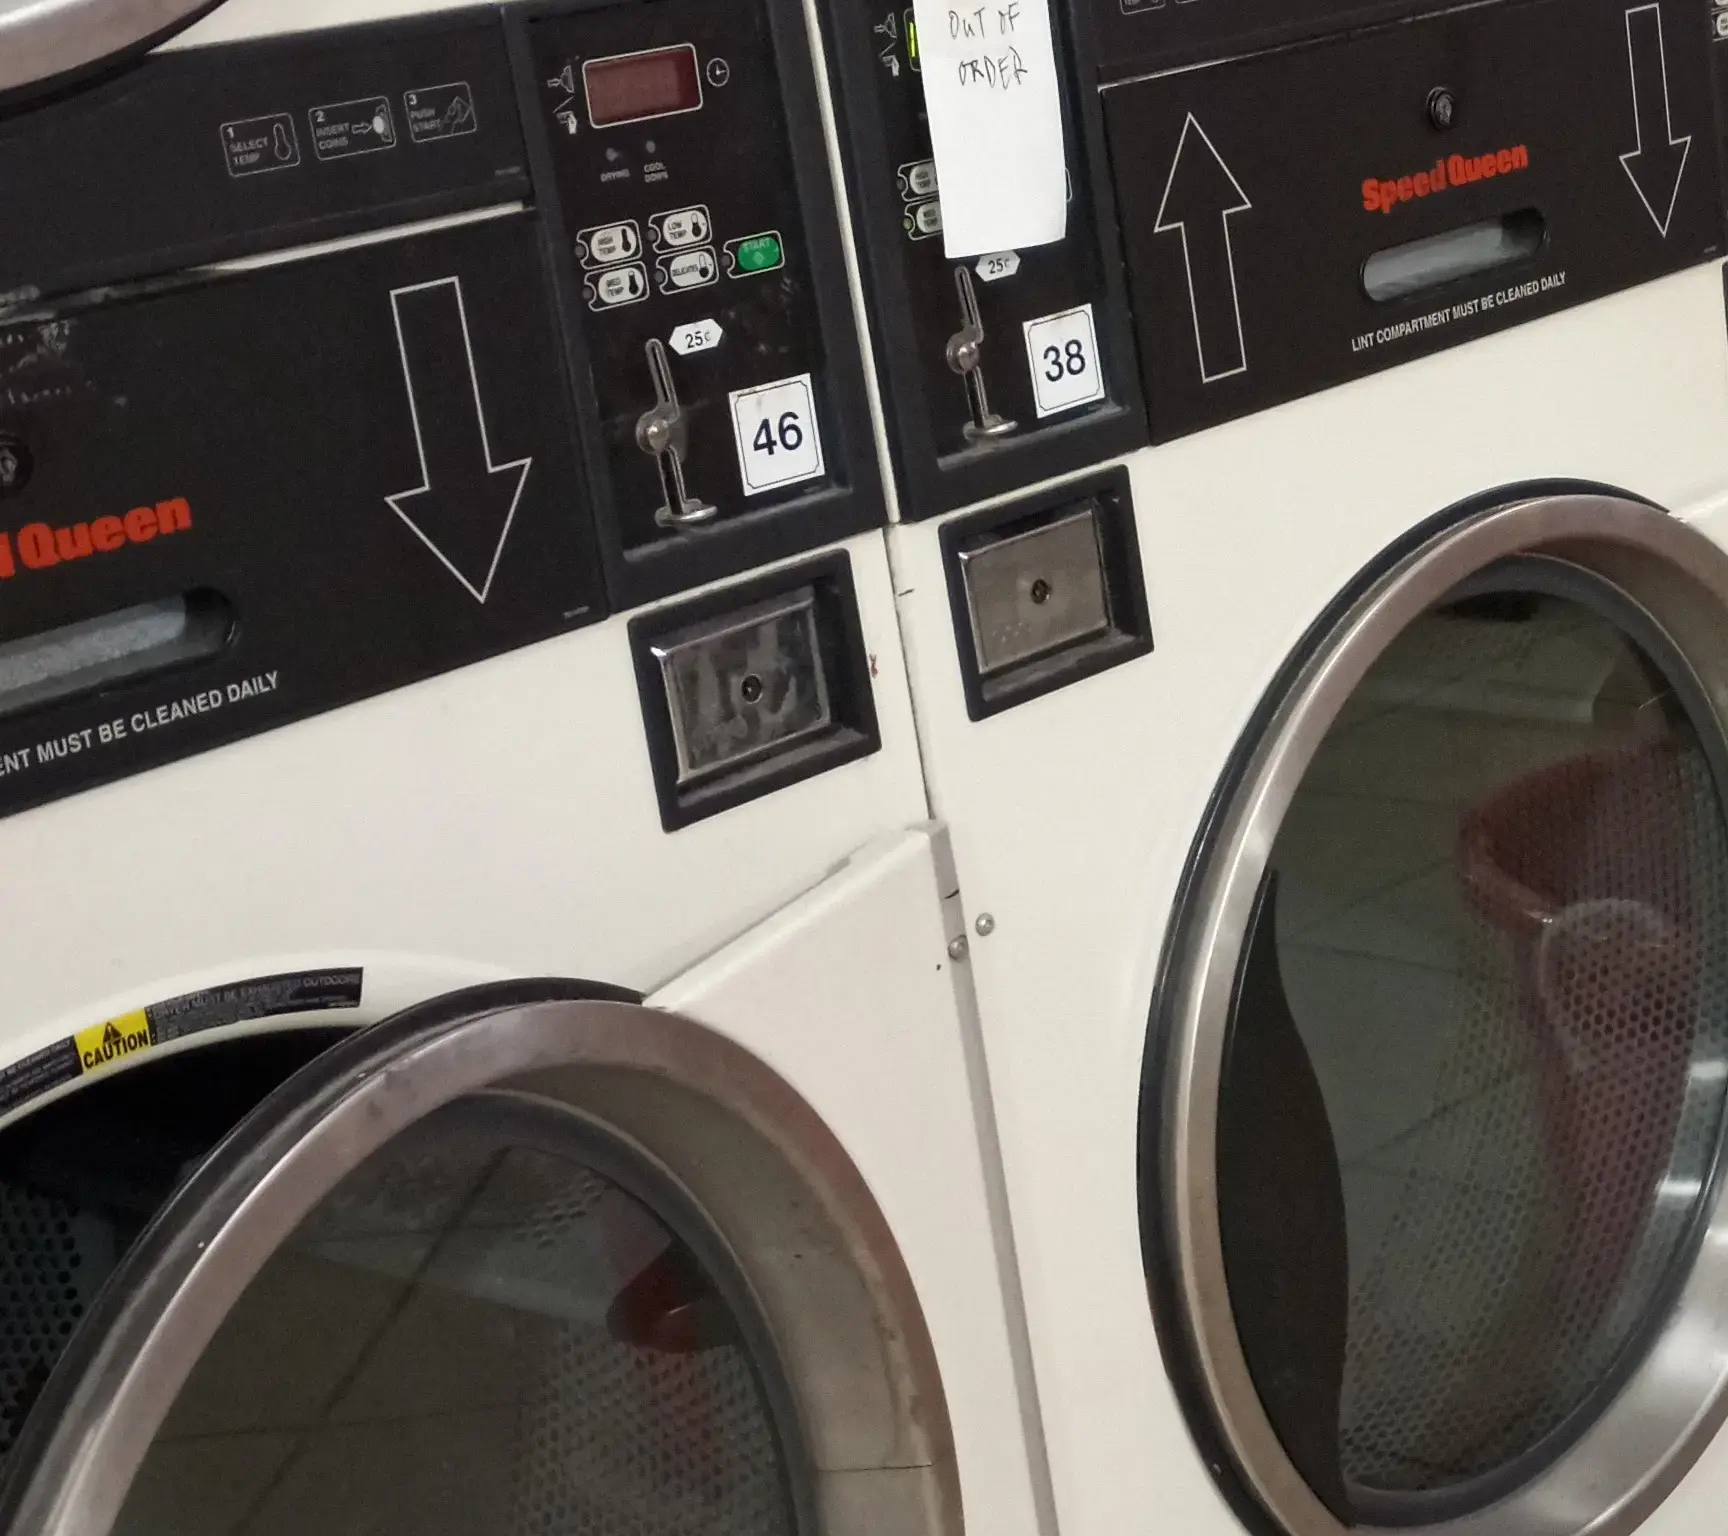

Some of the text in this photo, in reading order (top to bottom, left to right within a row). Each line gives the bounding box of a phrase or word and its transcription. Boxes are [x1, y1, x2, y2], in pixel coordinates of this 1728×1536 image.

[998, 1, 1021, 36] OF
[958, 46, 1028, 90] ORDER
[229, 137, 268, 153] SELECT
[1361, 144, 1529, 214] Speed Queen
[1351, 271, 1566, 352] LINT COMPARTMENT MUST BE CLEANED DAILY
[1043, 339, 1086, 382] 38
[752, 411, 803, 456] 46
[17, 497, 192, 569] Queen
[36, 728, 93, 765] MUST
[99, 718, 128, 744] BE
[131, 689, 223, 734] CLEANED
[228, 670, 279, 703] DAILY
[83, 1028, 149, 1070] CAUTION
